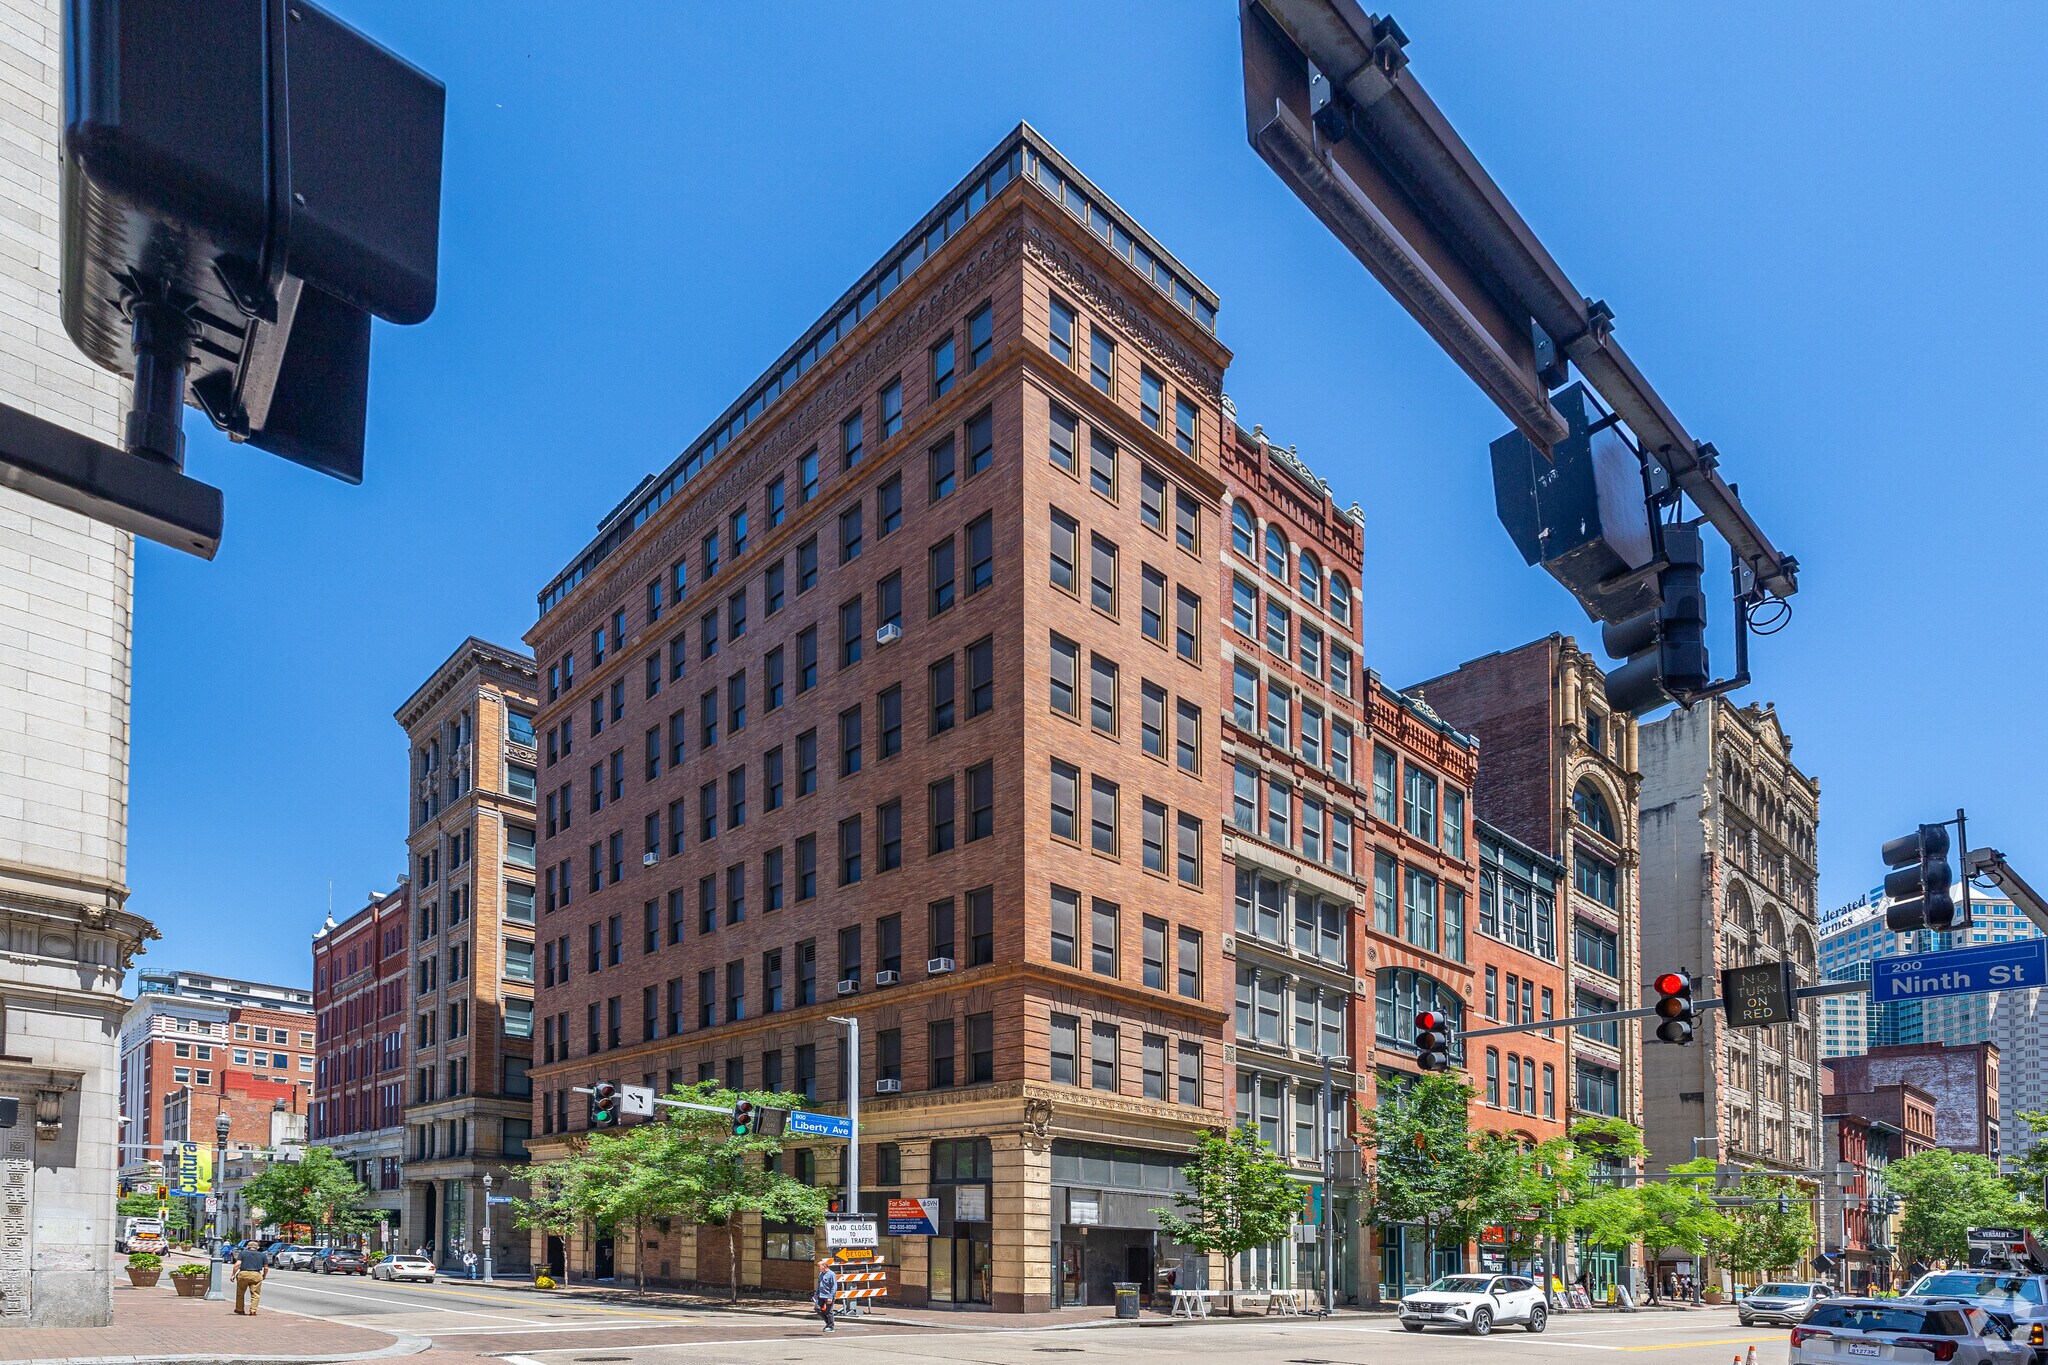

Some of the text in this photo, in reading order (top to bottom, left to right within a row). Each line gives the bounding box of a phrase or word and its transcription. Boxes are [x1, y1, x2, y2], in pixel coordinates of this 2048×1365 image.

[1892, 961, 1922, 973] 200
[1742, 972, 1769, 986] NO
[1892, 964, 2025, 995] Ninth St
[1738, 985, 1777, 997] TURN
[1747, 997, 1768, 1007] ON
[1743, 1007, 1773, 1020] RED
[795, 1121, 849, 1135] Liberty Ave
